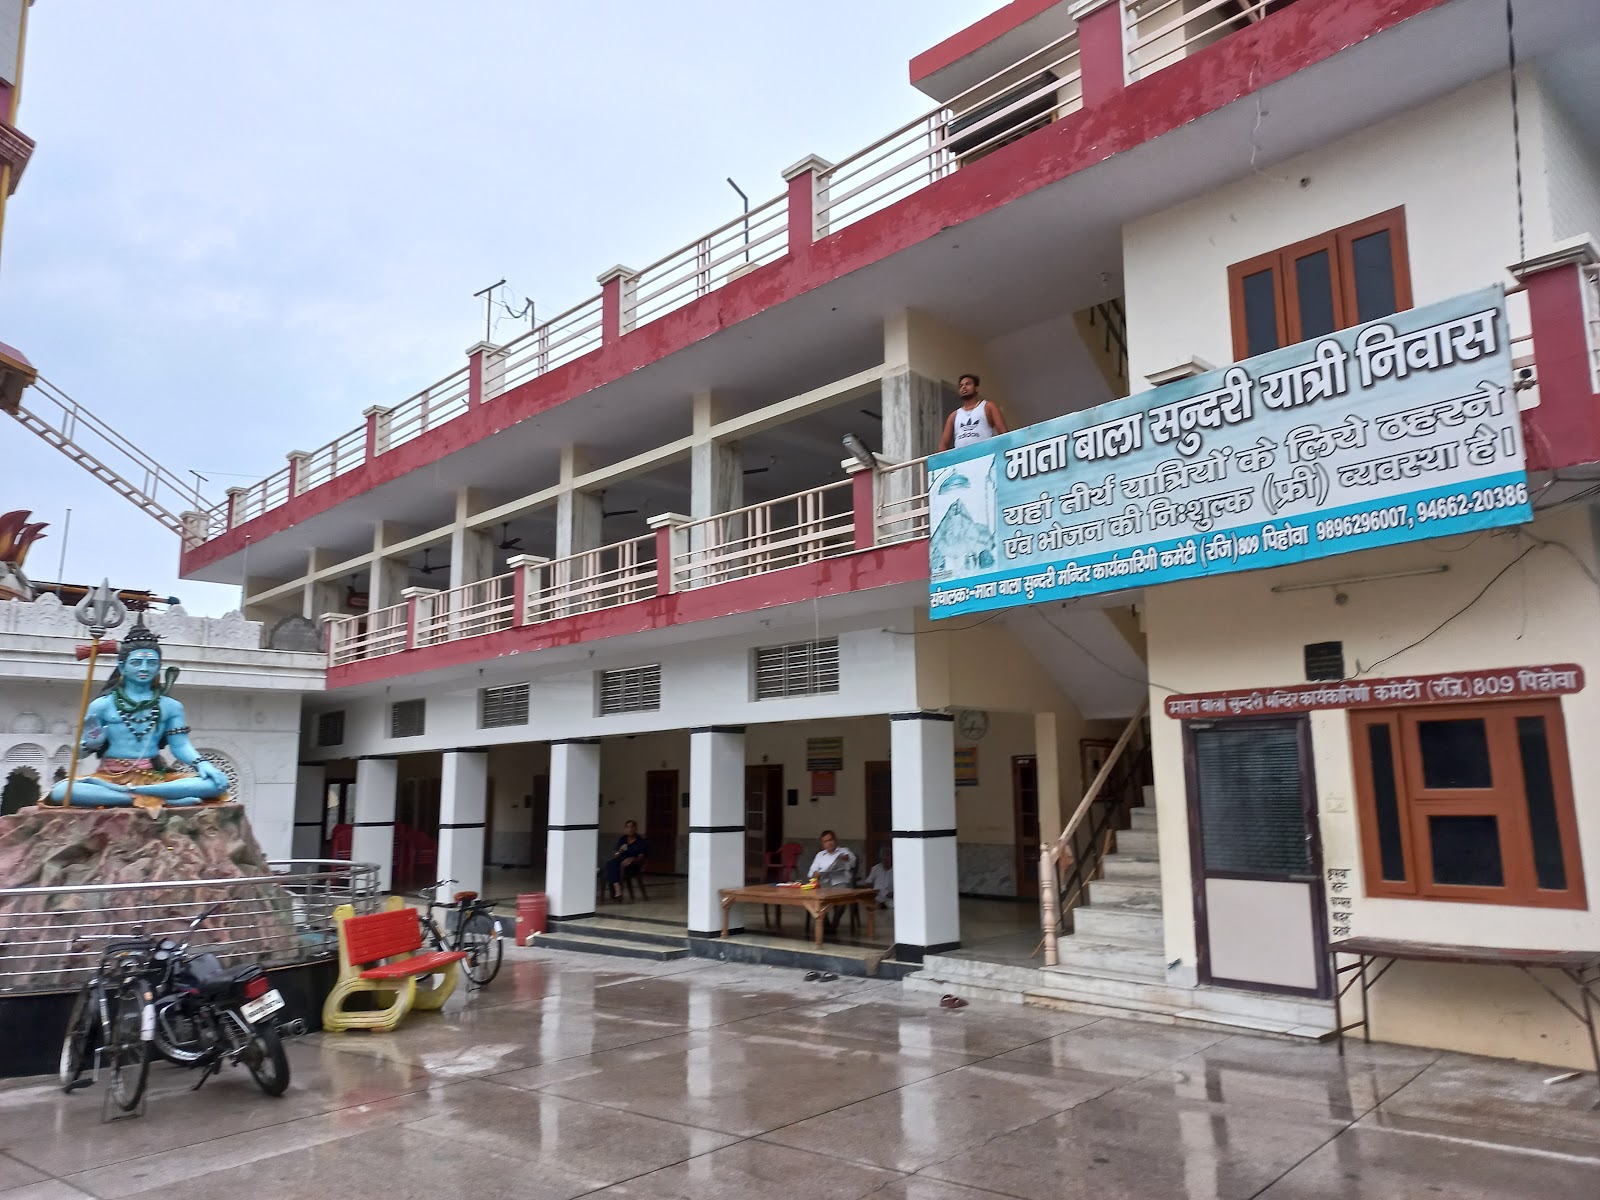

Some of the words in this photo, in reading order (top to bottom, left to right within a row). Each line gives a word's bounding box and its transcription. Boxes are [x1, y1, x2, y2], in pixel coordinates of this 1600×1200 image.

[1004, 433, 1069, 480] माता
[1072, 412, 1143, 463] बाला
[1149, 367, 1253, 456] सुन्दरी
[1261, 339, 1348, 411] यात्री
[1355, 308, 1498, 389] निवास
[1003, 491, 1054, 526] यहां
[1059, 473, 1116, 514] तीर्थ
[1120, 446, 1233, 499] यात्रियों
[1235, 437, 1278, 472] के
[1284, 415, 1368, 464] लिये
[1375, 381, 1506, 441] ठहरने
[1038, 521, 1105, 551] भोजन
[1109, 504, 1144, 537] की
[1262, 463, 1330, 516] (फ्री)
[1337, 441, 1461, 487] व्यवस्था
[1023, 565, 1056, 600] सुन्दरी
[1057, 561, 1092, 586] मन्दिर
[1092, 546, 1158, 580] कार्यकारिणी
[1160, 539, 1197, 569] कमेटी
[1262, 521, 1309, 551] पिहोवा
[1417, 482, 1528, 523] 94662-20386
[1168, 699, 1199, 714] माता
[1200, 698, 1227, 712] बाला
[1228, 691, 1264, 715] सुन्दरी
[1265, 689, 1299, 708] मन्दिर
[1300, 683, 1371, 706] कार्यकारिणी
[1374, 679, 1423, 700] कमेटी
[1517, 668, 1578, 692] पिहोवा
